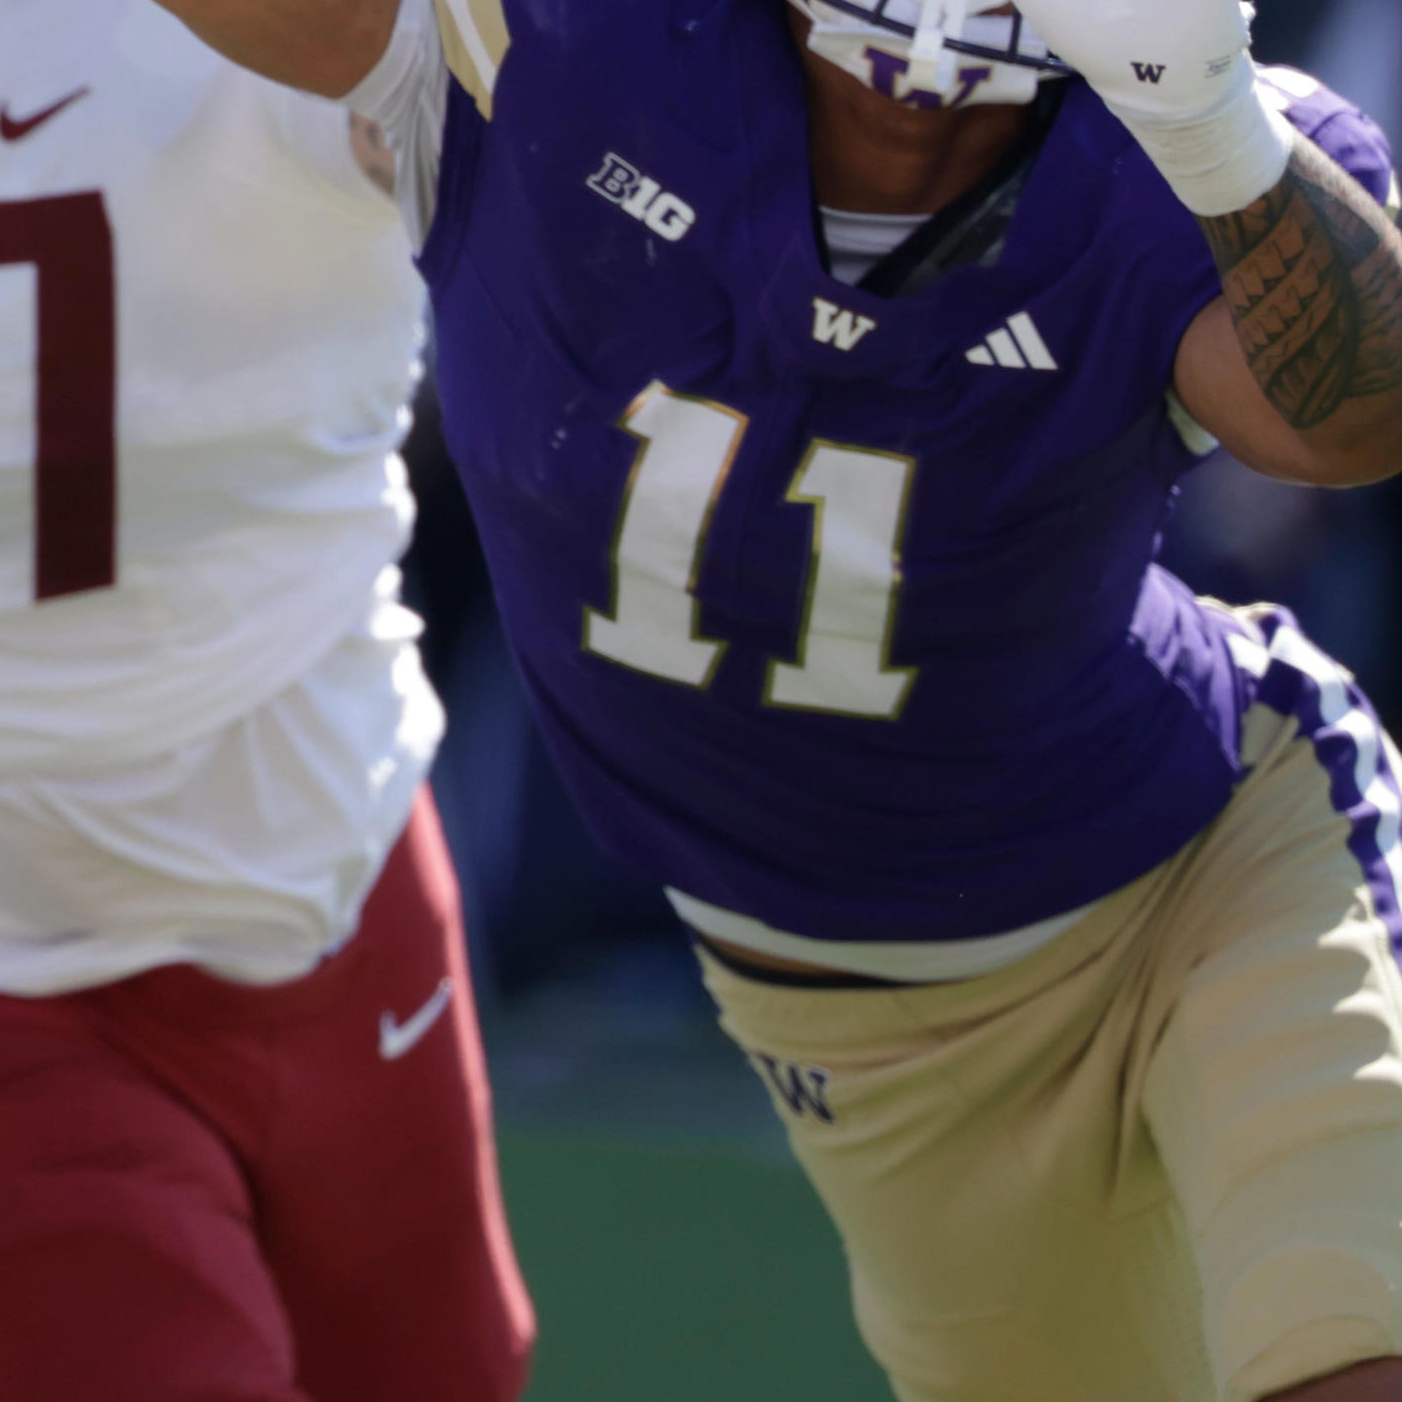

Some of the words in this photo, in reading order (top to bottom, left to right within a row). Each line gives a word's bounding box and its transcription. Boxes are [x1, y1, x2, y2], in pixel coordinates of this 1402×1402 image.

[1130, 61, 1166, 85] W
[812, 297, 877, 351] W
[582, 379, 919, 721] 11
